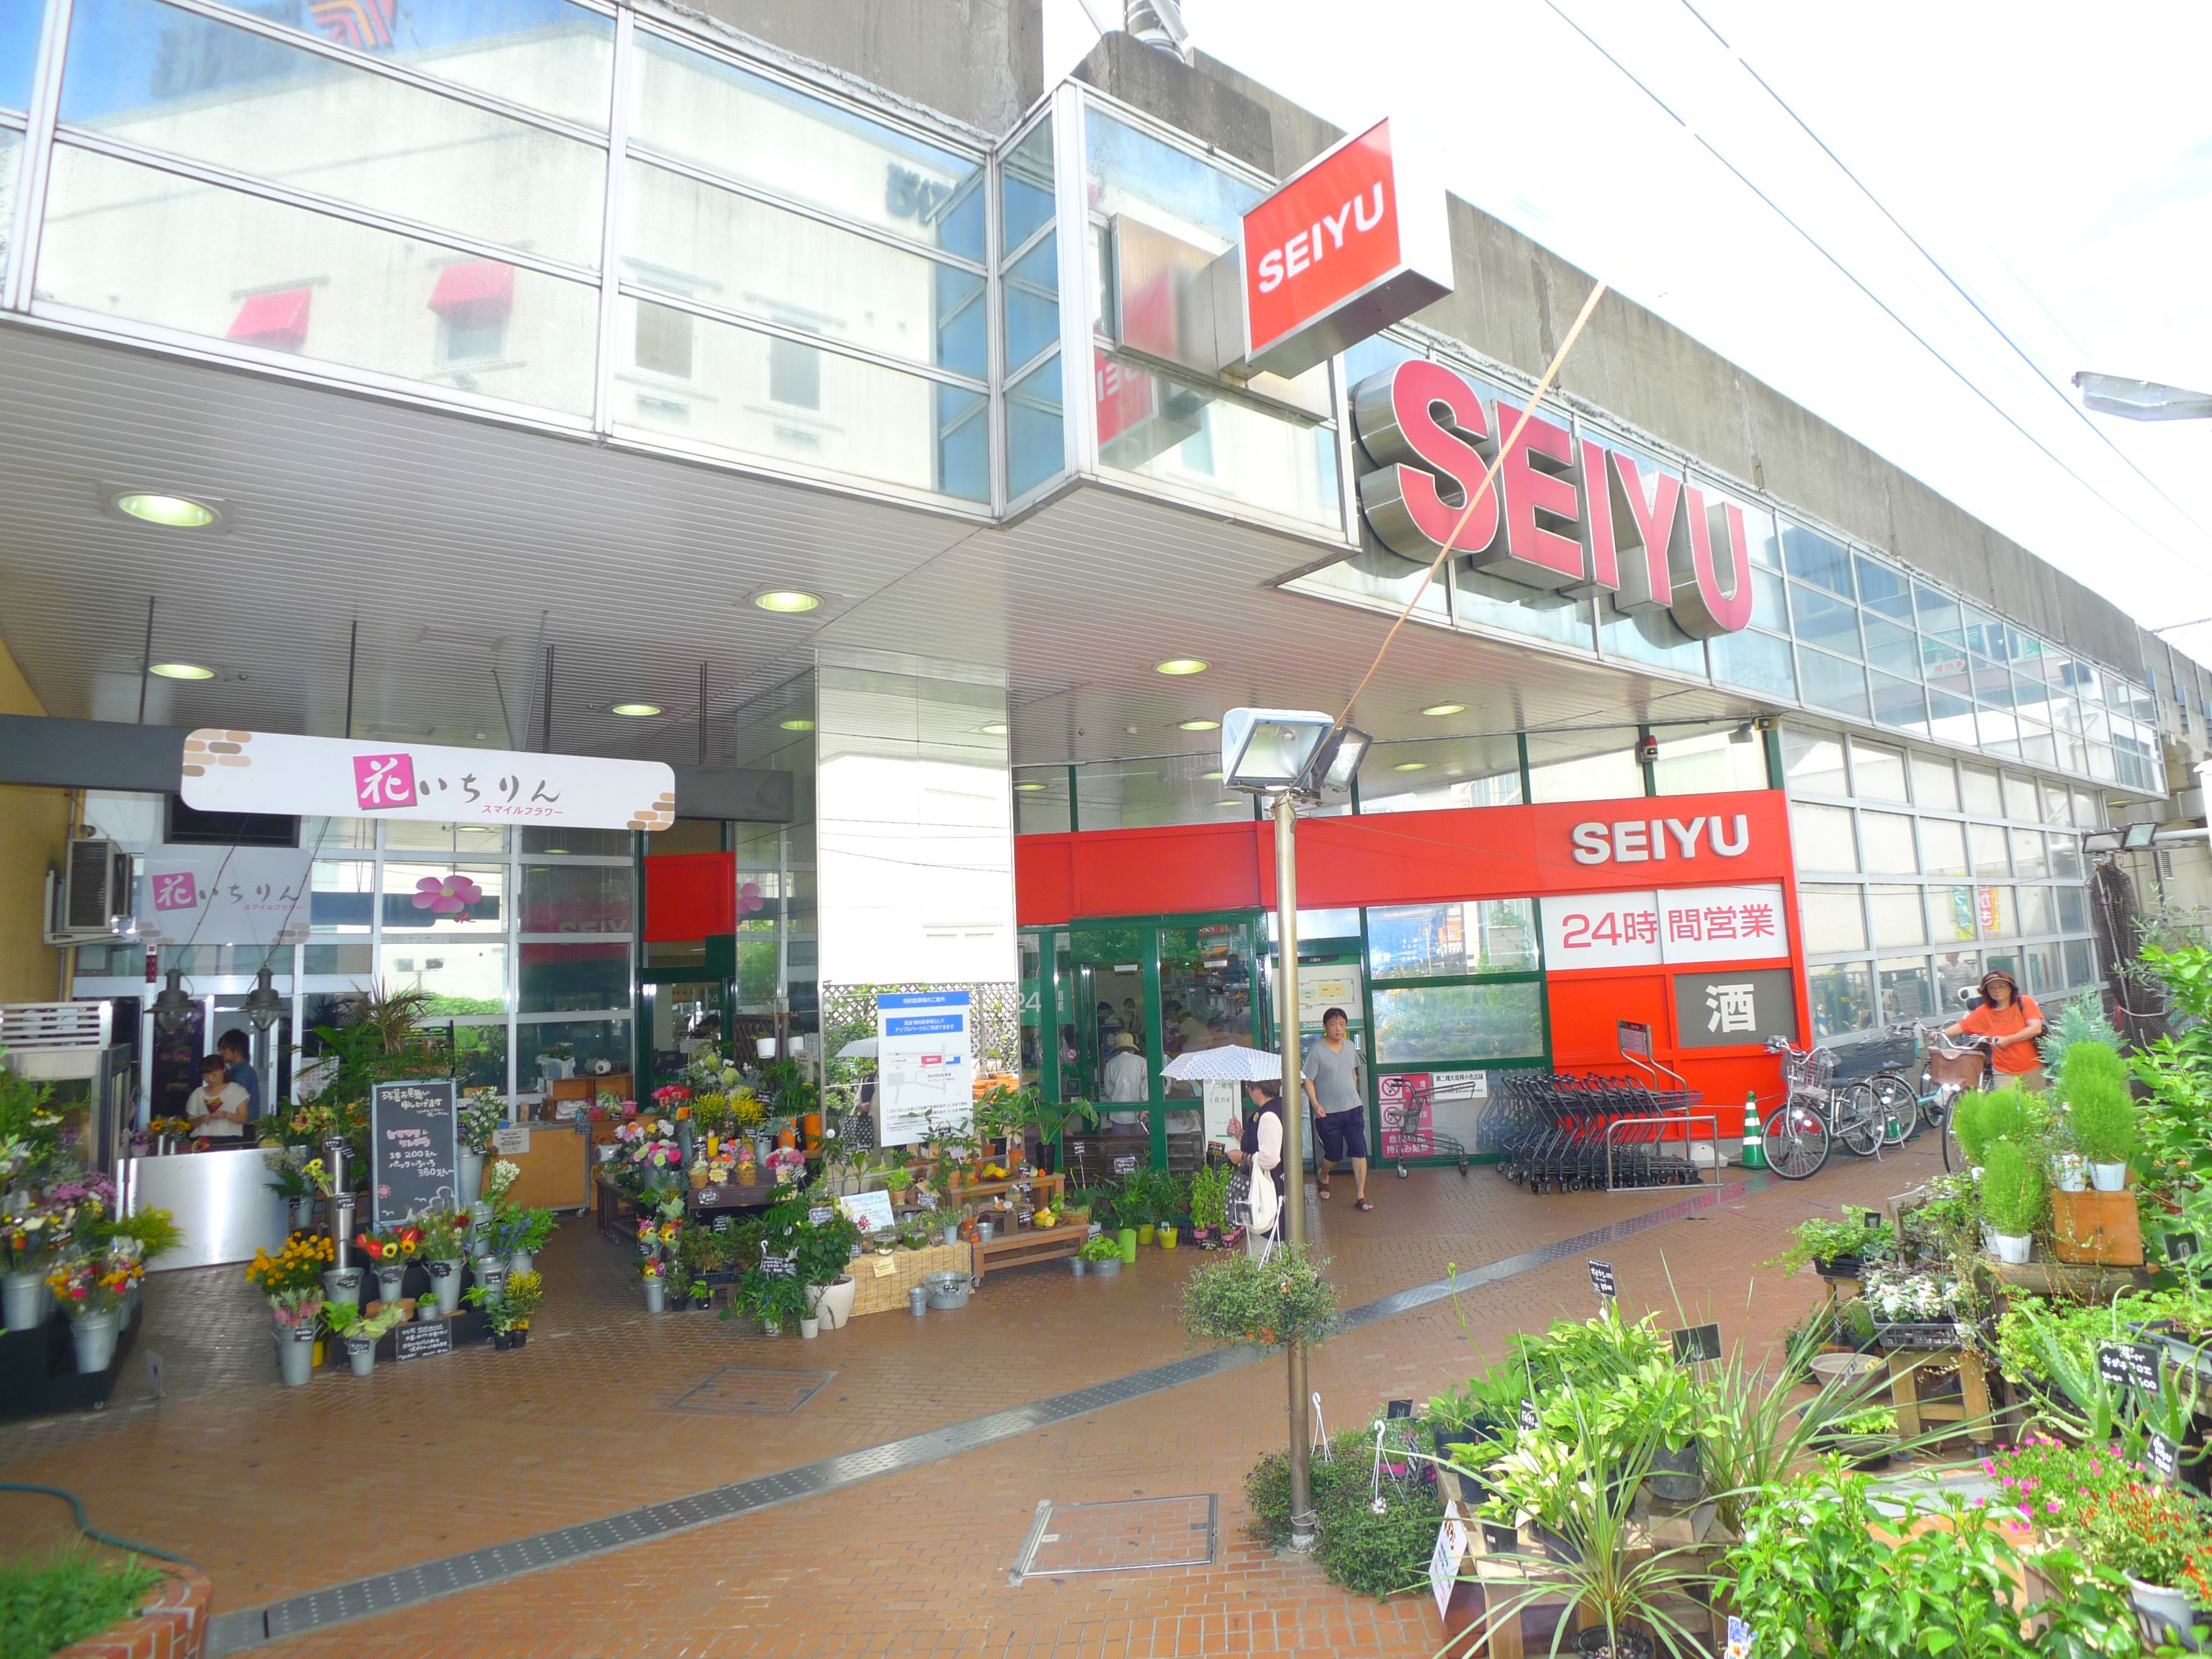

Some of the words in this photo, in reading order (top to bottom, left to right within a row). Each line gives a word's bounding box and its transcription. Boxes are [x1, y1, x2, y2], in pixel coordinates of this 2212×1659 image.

[1257, 182, 1384, 294] SEIYU
[1386, 359, 1754, 637] SEIYU
[359, 756, 562, 804] 花いちりん
[482, 804, 563, 817] スマイルフラワー
[1570, 813, 1750, 866] SEIYU
[156, 874, 299, 907] 花いちりん
[1561, 904, 1776, 949] 24時間営業
[1704, 981, 1758, 1033] 酒
